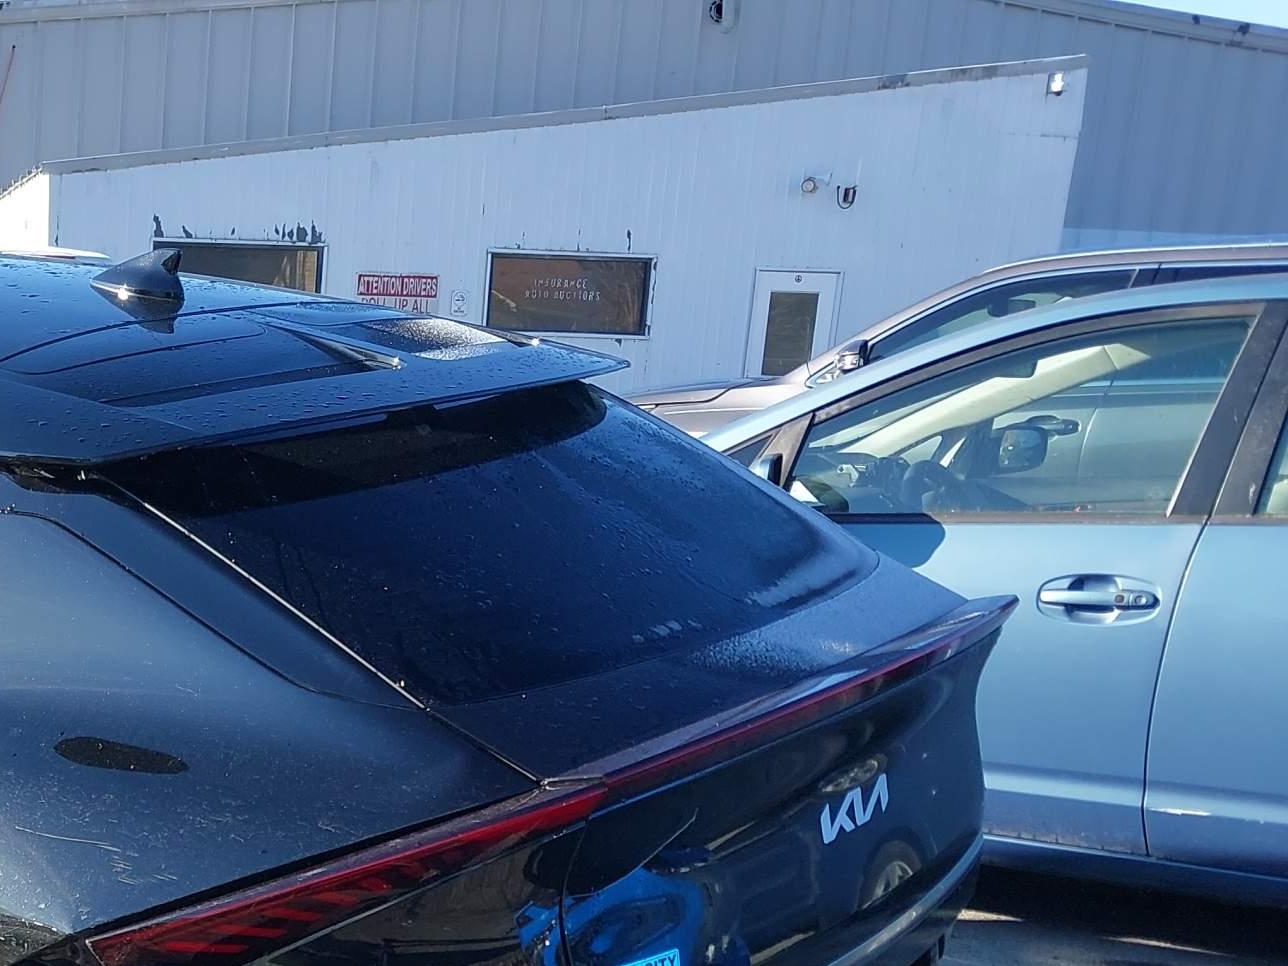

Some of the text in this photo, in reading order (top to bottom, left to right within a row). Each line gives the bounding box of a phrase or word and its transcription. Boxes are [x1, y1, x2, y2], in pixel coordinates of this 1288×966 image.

[358, 276, 437, 297] ATTENTION DRIVERS
[534, 278, 588, 288] INSURANCE
[820, 773, 889, 844] KIA
